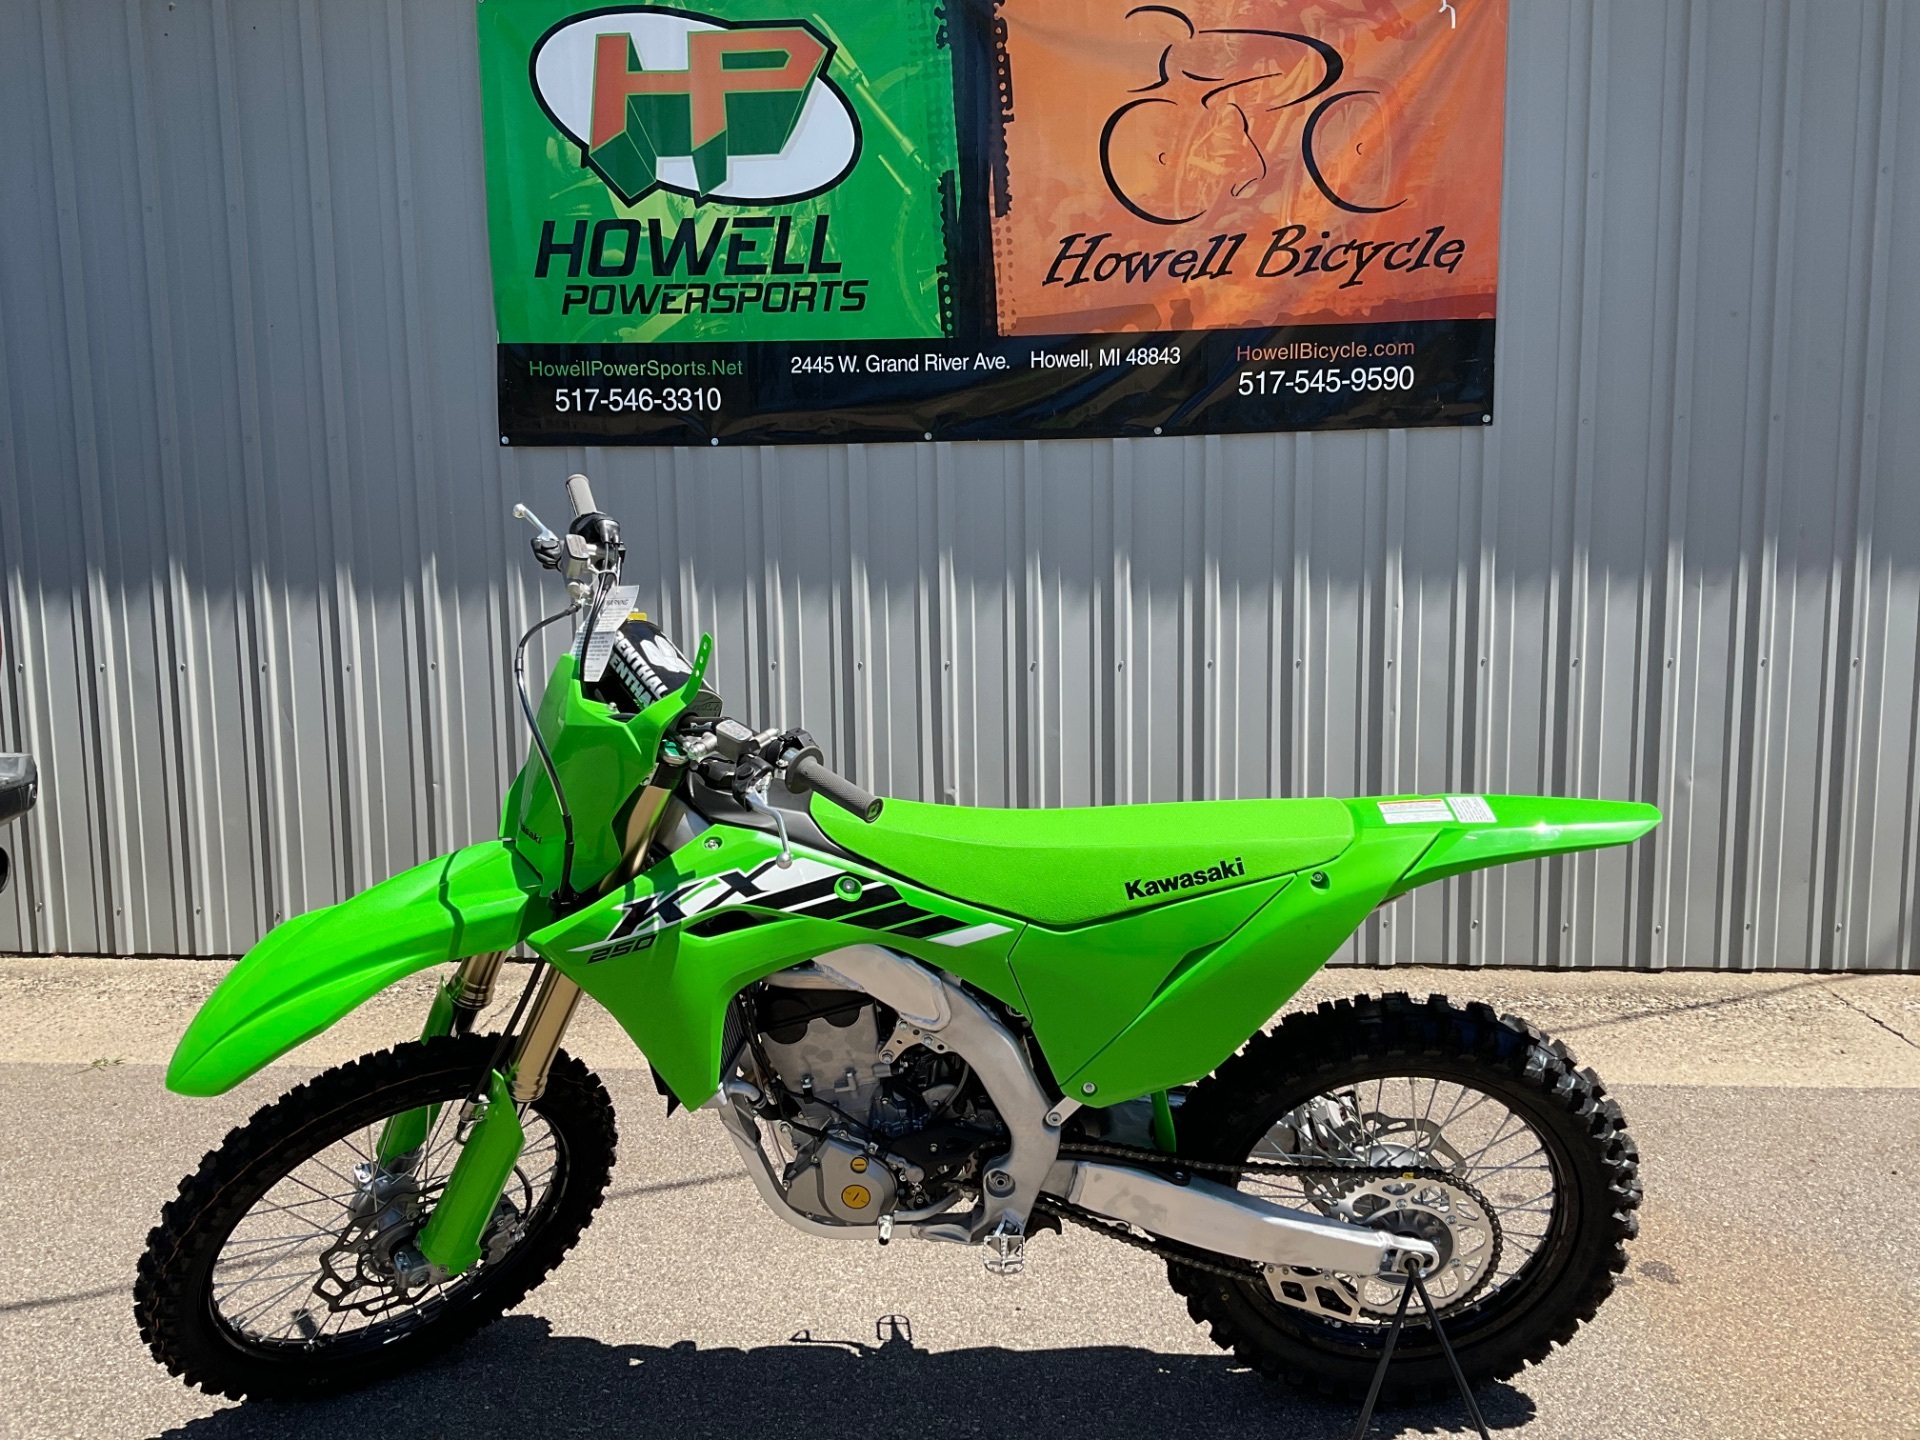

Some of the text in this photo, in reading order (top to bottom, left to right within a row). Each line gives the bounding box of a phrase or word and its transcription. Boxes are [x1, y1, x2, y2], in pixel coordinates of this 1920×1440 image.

[590, 27, 828, 153] HP
[534, 216, 842, 278] HOWELL
[1042, 224, 1466, 289] Howell Bicycle
[561, 279, 869, 316] POWERSPORTS
[790, 351, 1011, 374] 2445 W. Grand River Ave.
[1030, 346, 1181, 370] Howell, MI 48843
[1237, 341, 1415, 362] HowellBicycle.com
[529, 359, 744, 379] HowellPowerSports.Net
[1238, 366, 1415, 396] 517-545-9590
[555, 387, 722, 412] 517-546-3310
[609, 652, 656, 708] ENTHA
[1124, 857, 1245, 901] Kawasaki
[606, 859, 777, 943] KX
[586, 933, 658, 965] 250
